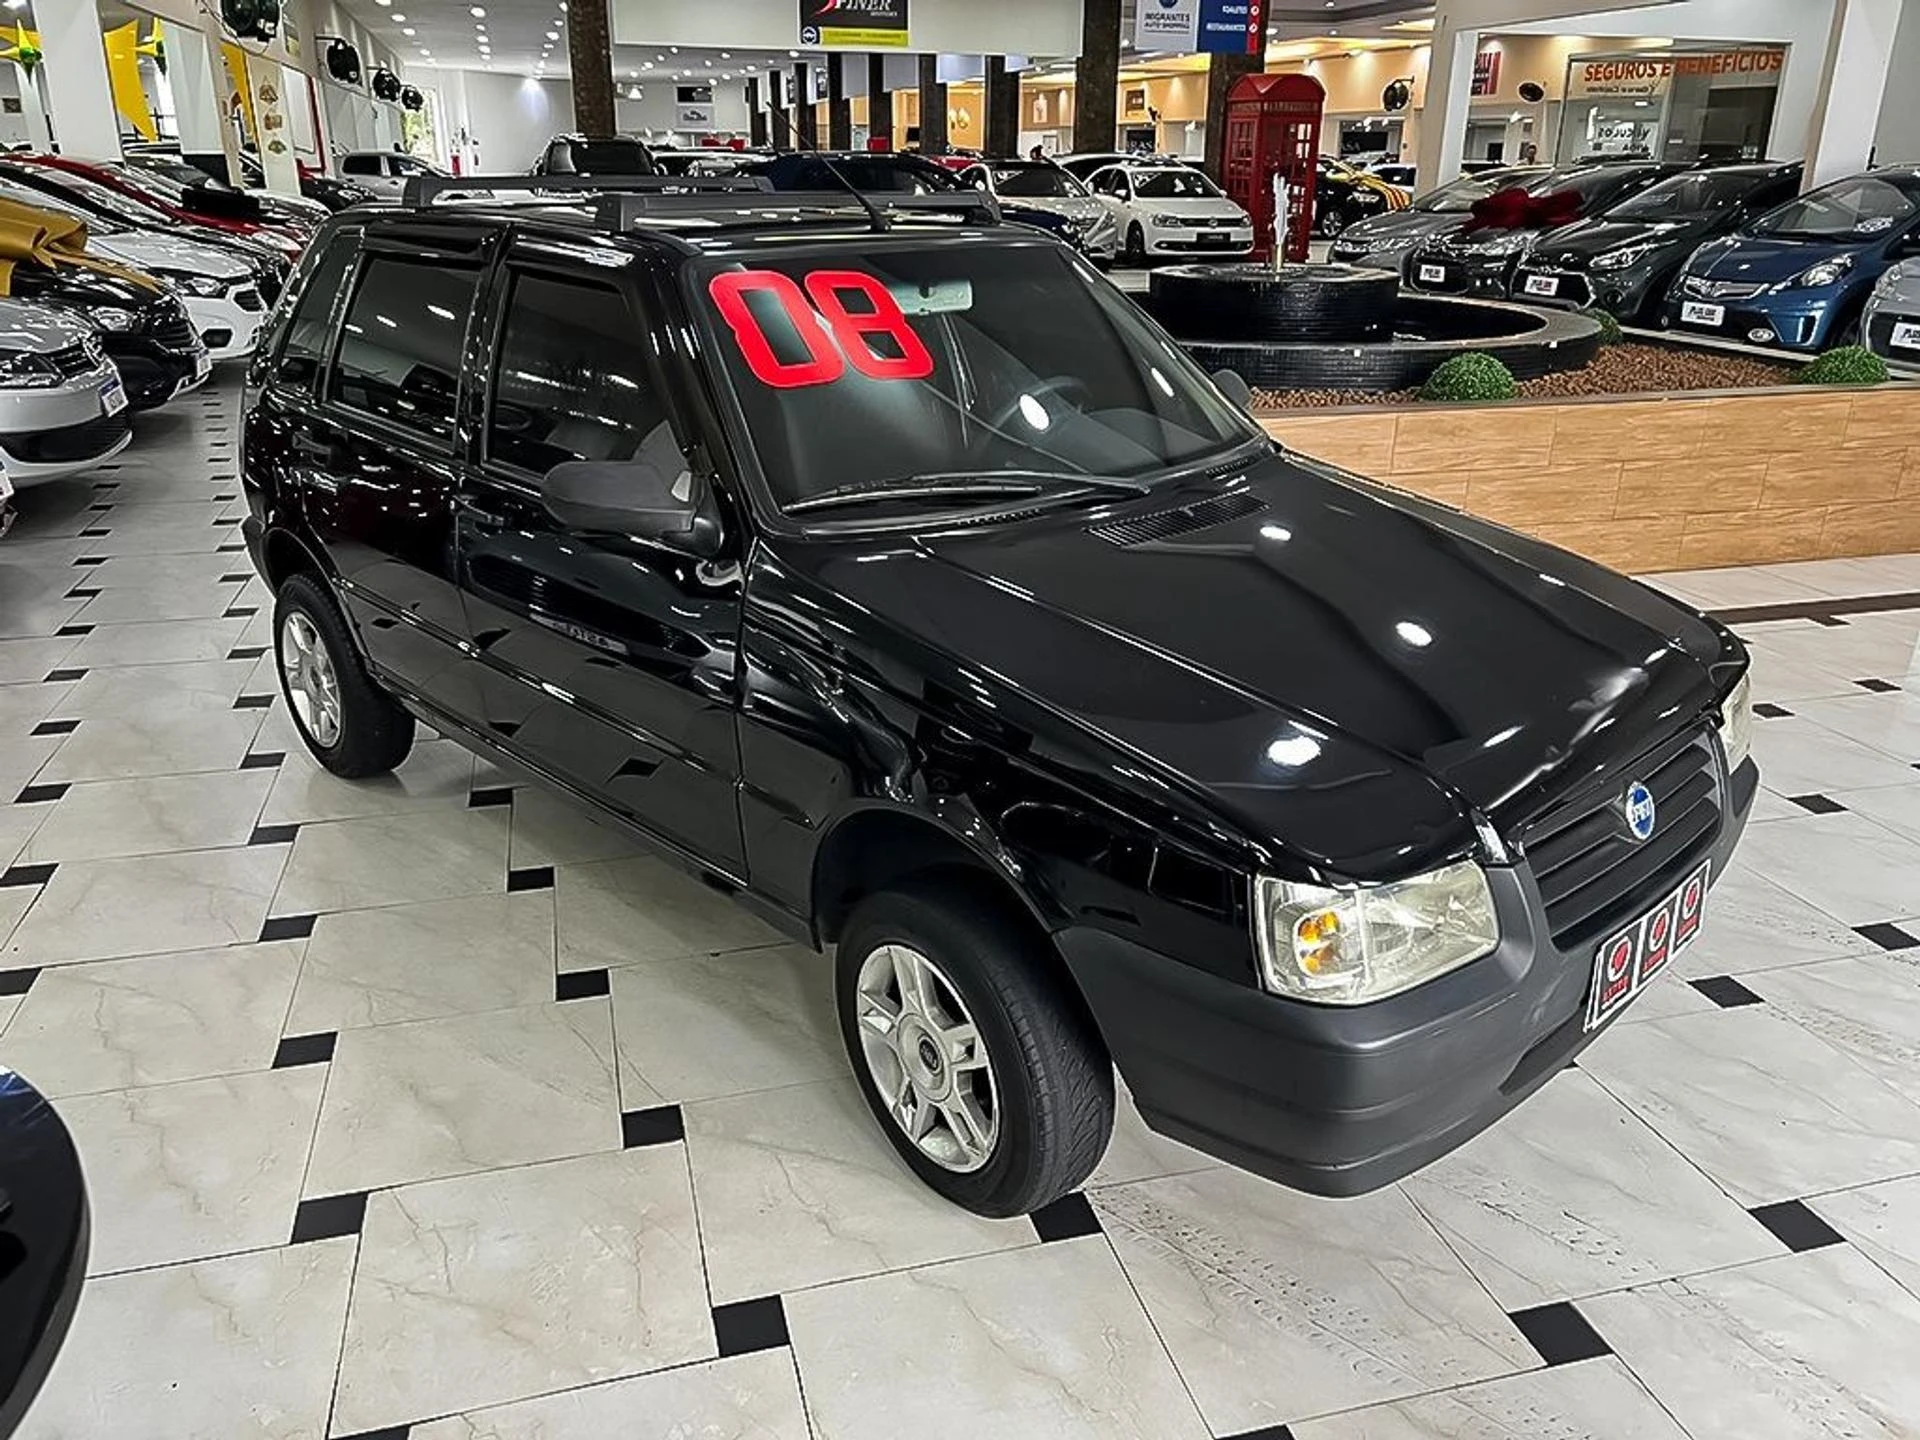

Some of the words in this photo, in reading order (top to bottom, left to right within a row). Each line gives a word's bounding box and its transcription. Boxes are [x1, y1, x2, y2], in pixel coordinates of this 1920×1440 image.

[1584, 60, 1657, 83] SEGUROS
[1659, 61, 1672, 78] E
[710, 270, 933, 387] 08
